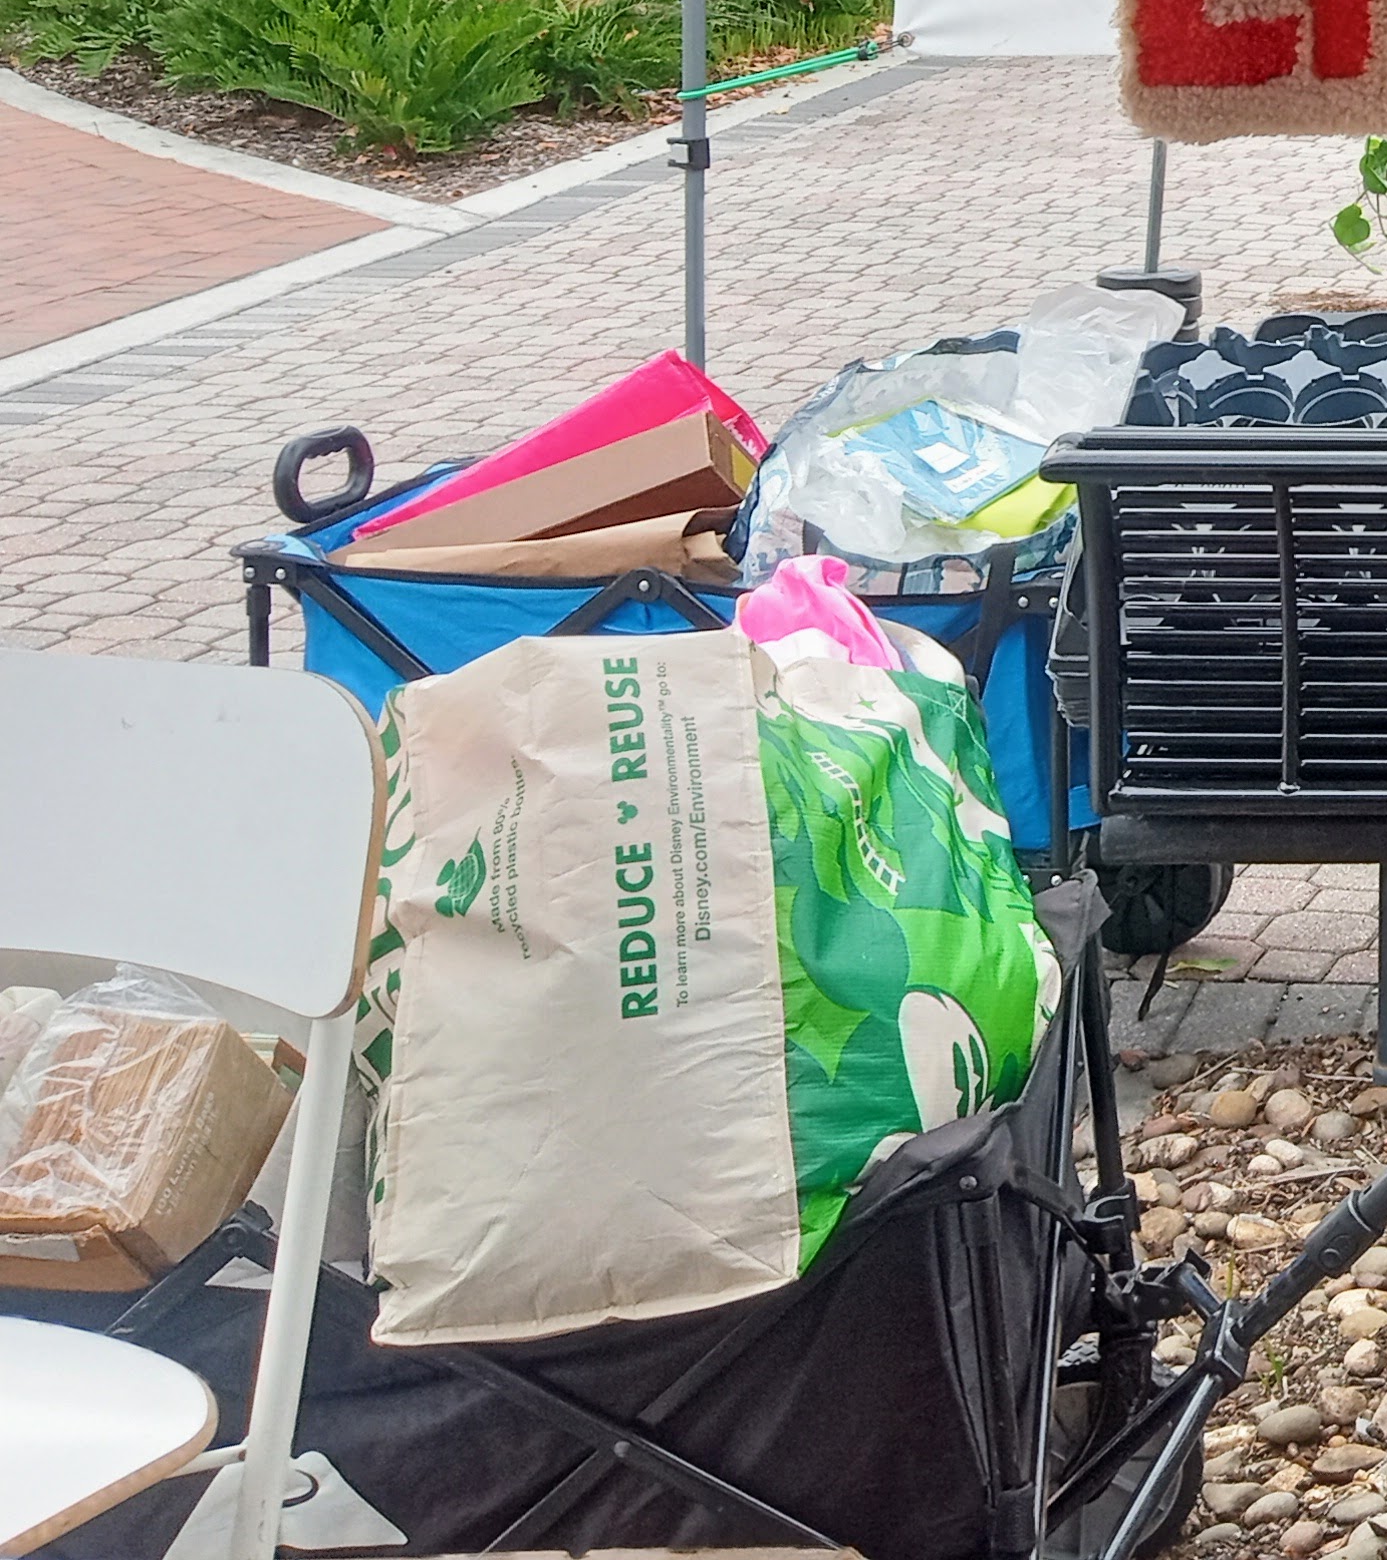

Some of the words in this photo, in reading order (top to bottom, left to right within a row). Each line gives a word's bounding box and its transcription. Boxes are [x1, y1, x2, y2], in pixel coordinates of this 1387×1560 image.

[656, 662, 667, 679] to:
[660, 681, 671, 696] go
[603, 657, 648, 782] REUSE
[506, 821, 519, 880] plastic
[670, 819, 683, 867] Disney
[680, 716, 712, 942] Disney.com/Environment
[491, 838, 502, 880] from
[489, 884, 506, 934] Made
[672, 867, 685, 907] about
[505, 886, 531, 960] recycled
[615, 842, 658, 1019] REDUCE
[675, 911, 686, 948] more
[676, 951, 688, 987] learn
[676, 991, 689, 1008] To
